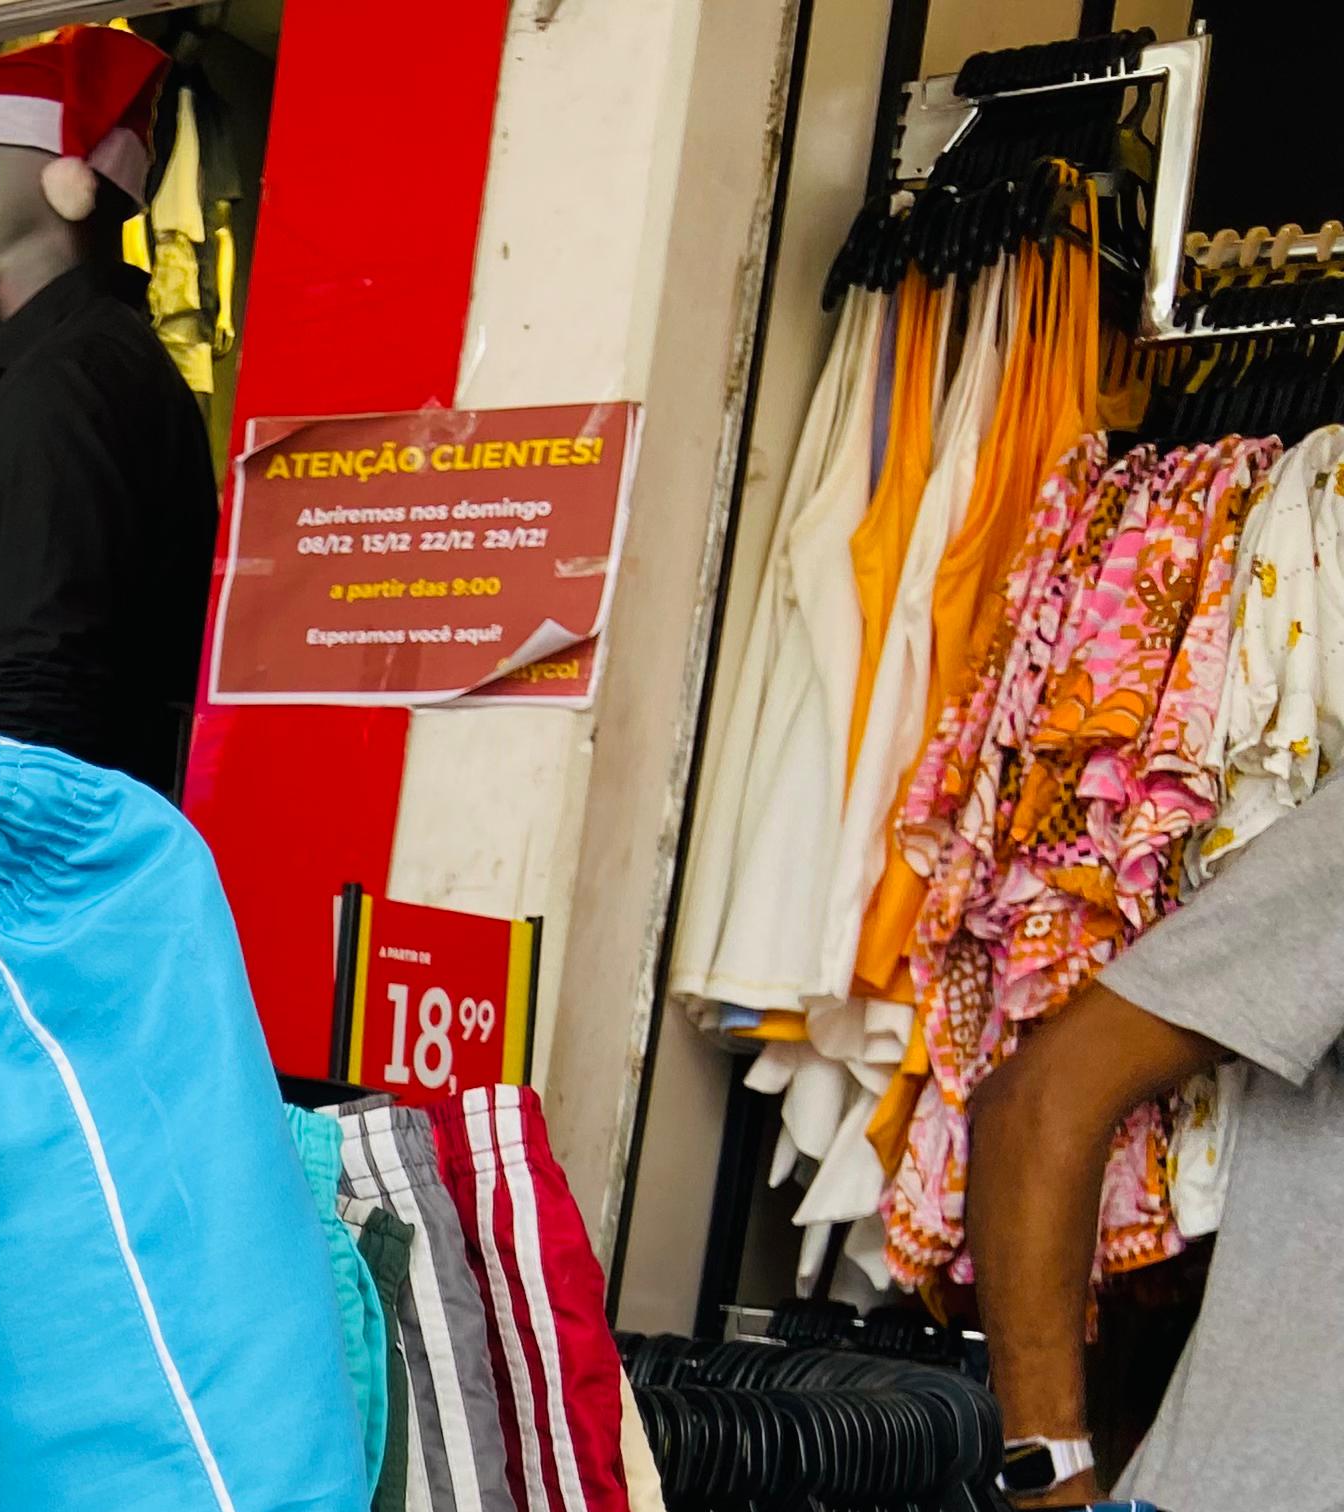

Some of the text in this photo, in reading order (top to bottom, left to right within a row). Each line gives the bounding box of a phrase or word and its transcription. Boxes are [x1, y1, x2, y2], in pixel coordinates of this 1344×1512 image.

[266, 437, 604, 483] ATENÇÃO CLIENTES!
[297, 498, 552, 526] Abriremos nos domingo
[297, 533, 354, 555] 08/12
[362, 531, 411, 554] 15/12
[419, 529, 475, 551] 22/12
[330, 576, 501, 603] a partir das 9:00
[306, 628, 405, 648] Esperamos
[409, 625, 452, 643] você
